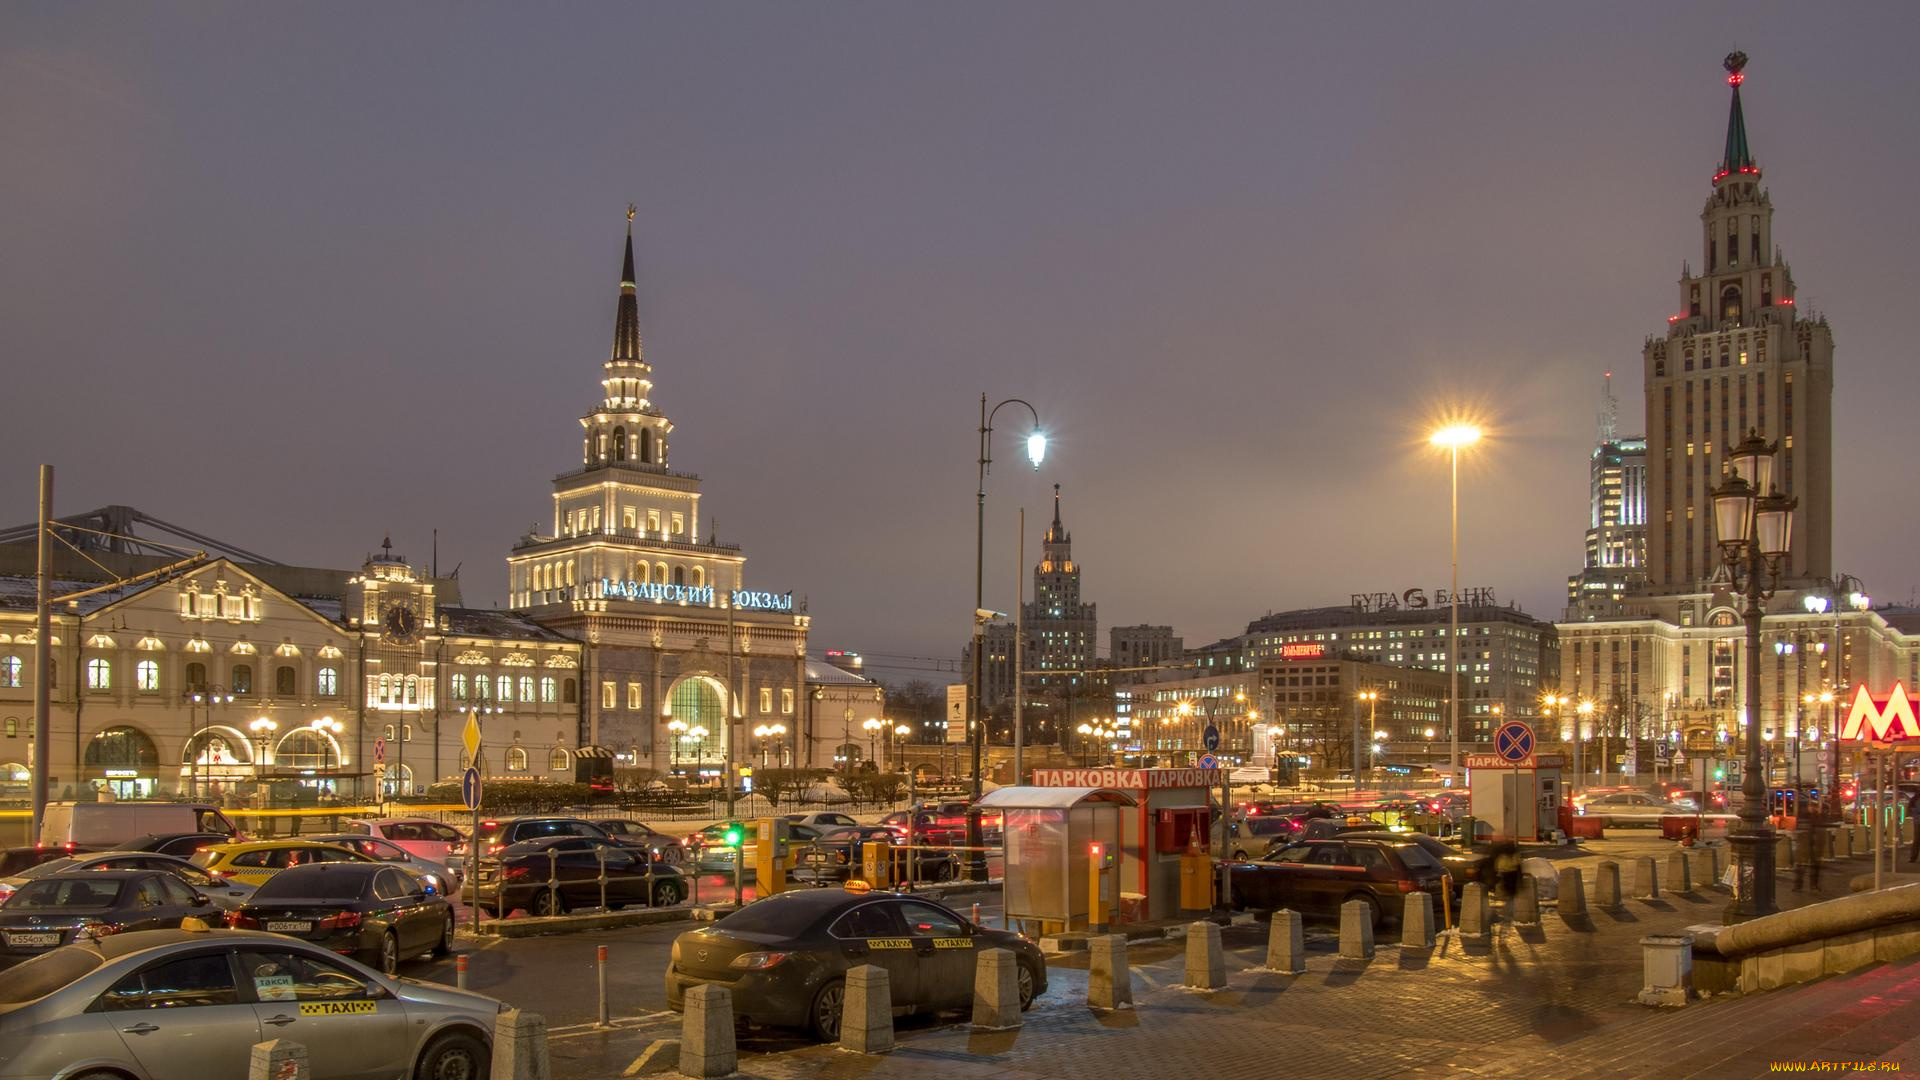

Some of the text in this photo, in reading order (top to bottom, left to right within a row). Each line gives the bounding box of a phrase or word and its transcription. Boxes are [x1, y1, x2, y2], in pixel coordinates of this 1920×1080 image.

[602, 578, 714, 603] КАЗАНСКИЙ
[1350, 587, 1496, 610] ГУТА БАНК
[1035, 770, 1144, 789] ПАРКОВКА
[1149, 770, 1220, 788] ПАРКОВКА
[260, 978, 289, 986] такси
[321, 1003, 356, 1014] TAXI
